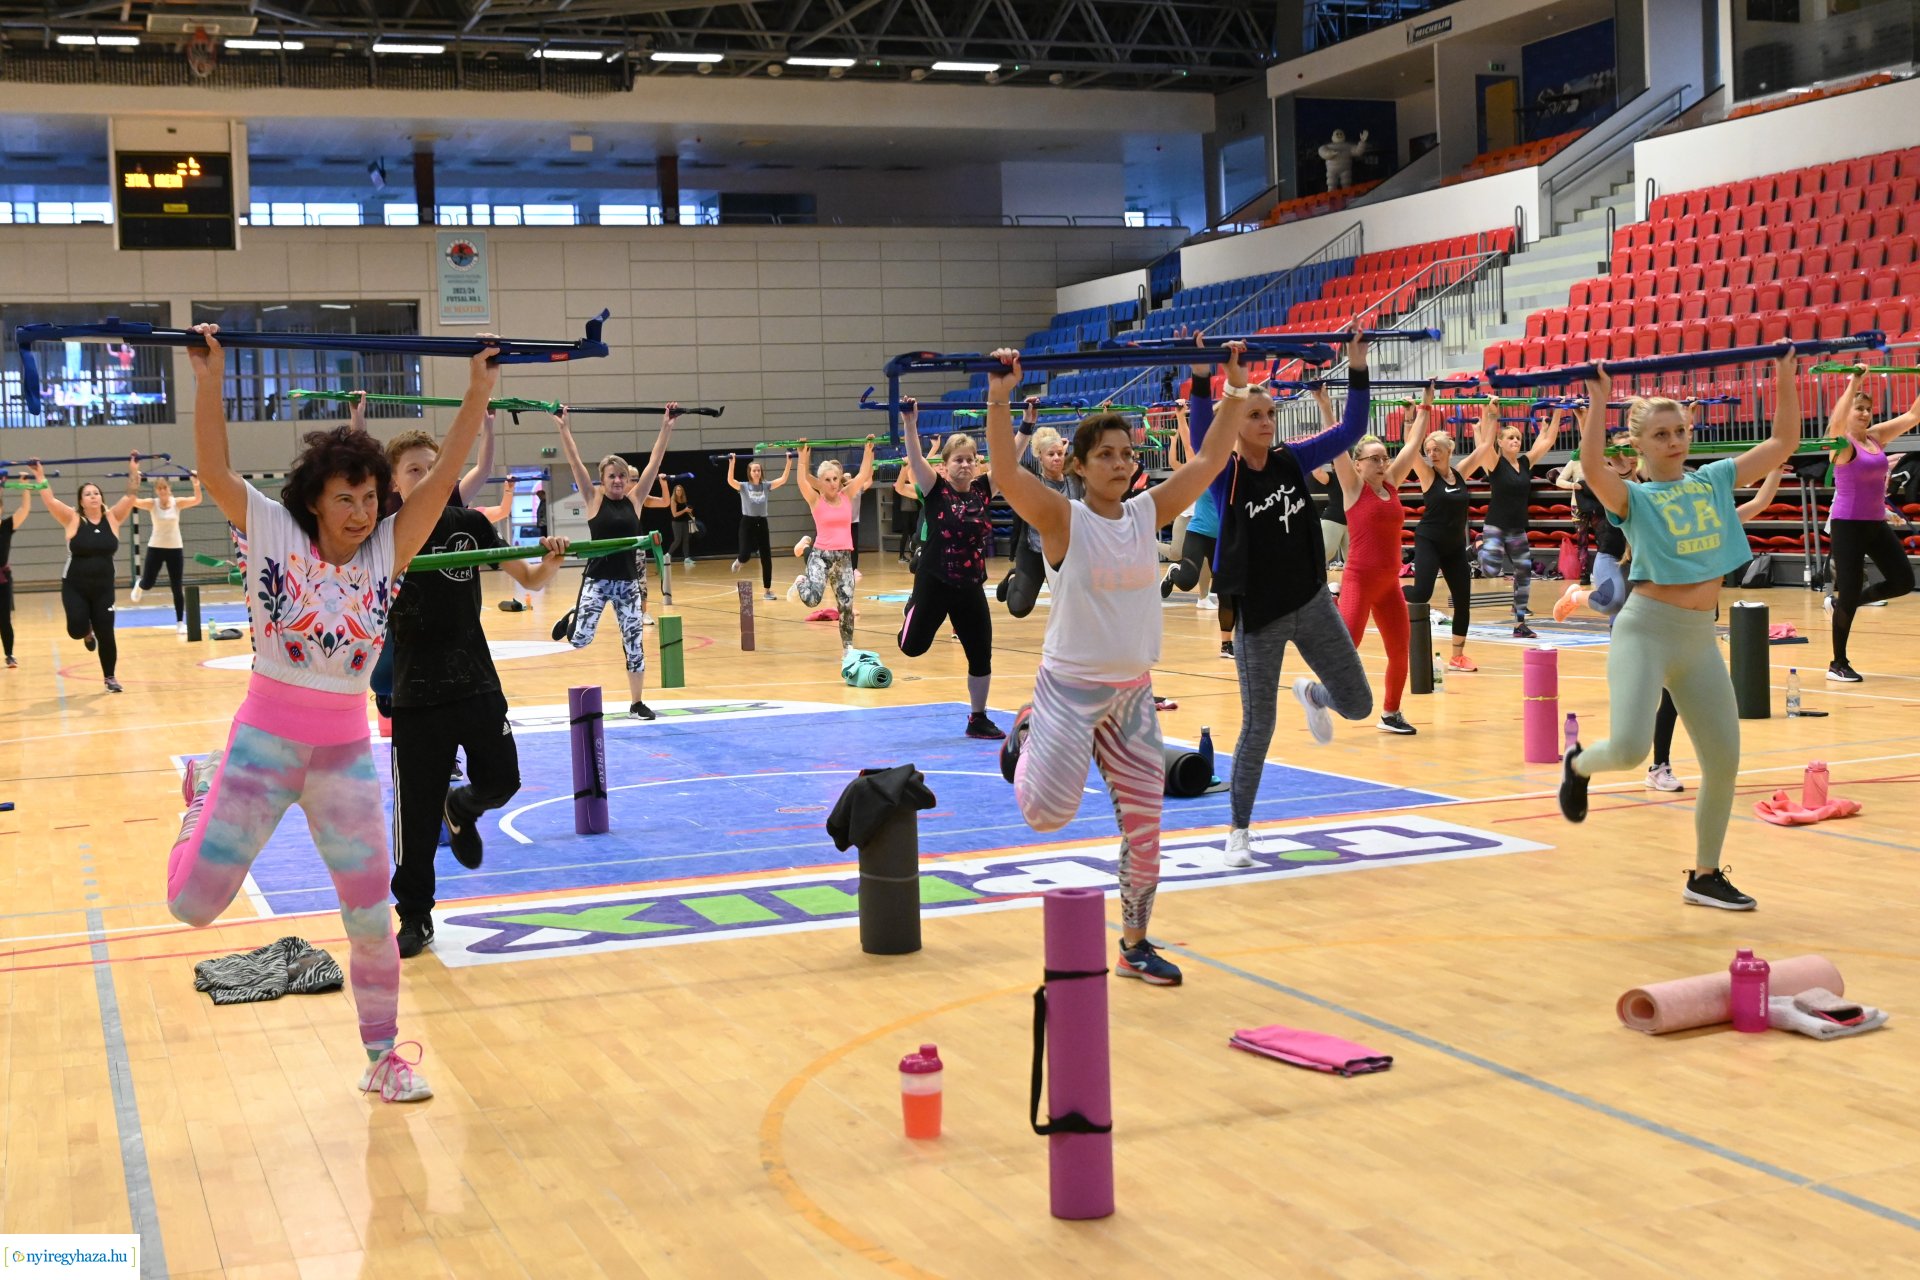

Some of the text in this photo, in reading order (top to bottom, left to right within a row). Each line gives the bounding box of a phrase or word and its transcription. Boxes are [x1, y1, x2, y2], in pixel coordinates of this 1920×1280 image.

[1415, 19, 1451, 38] MICHELIN
[1245, 484, 1296, 519] move
[1663, 499, 1722, 536] CA
[597, 751, 605, 784] TREXO
